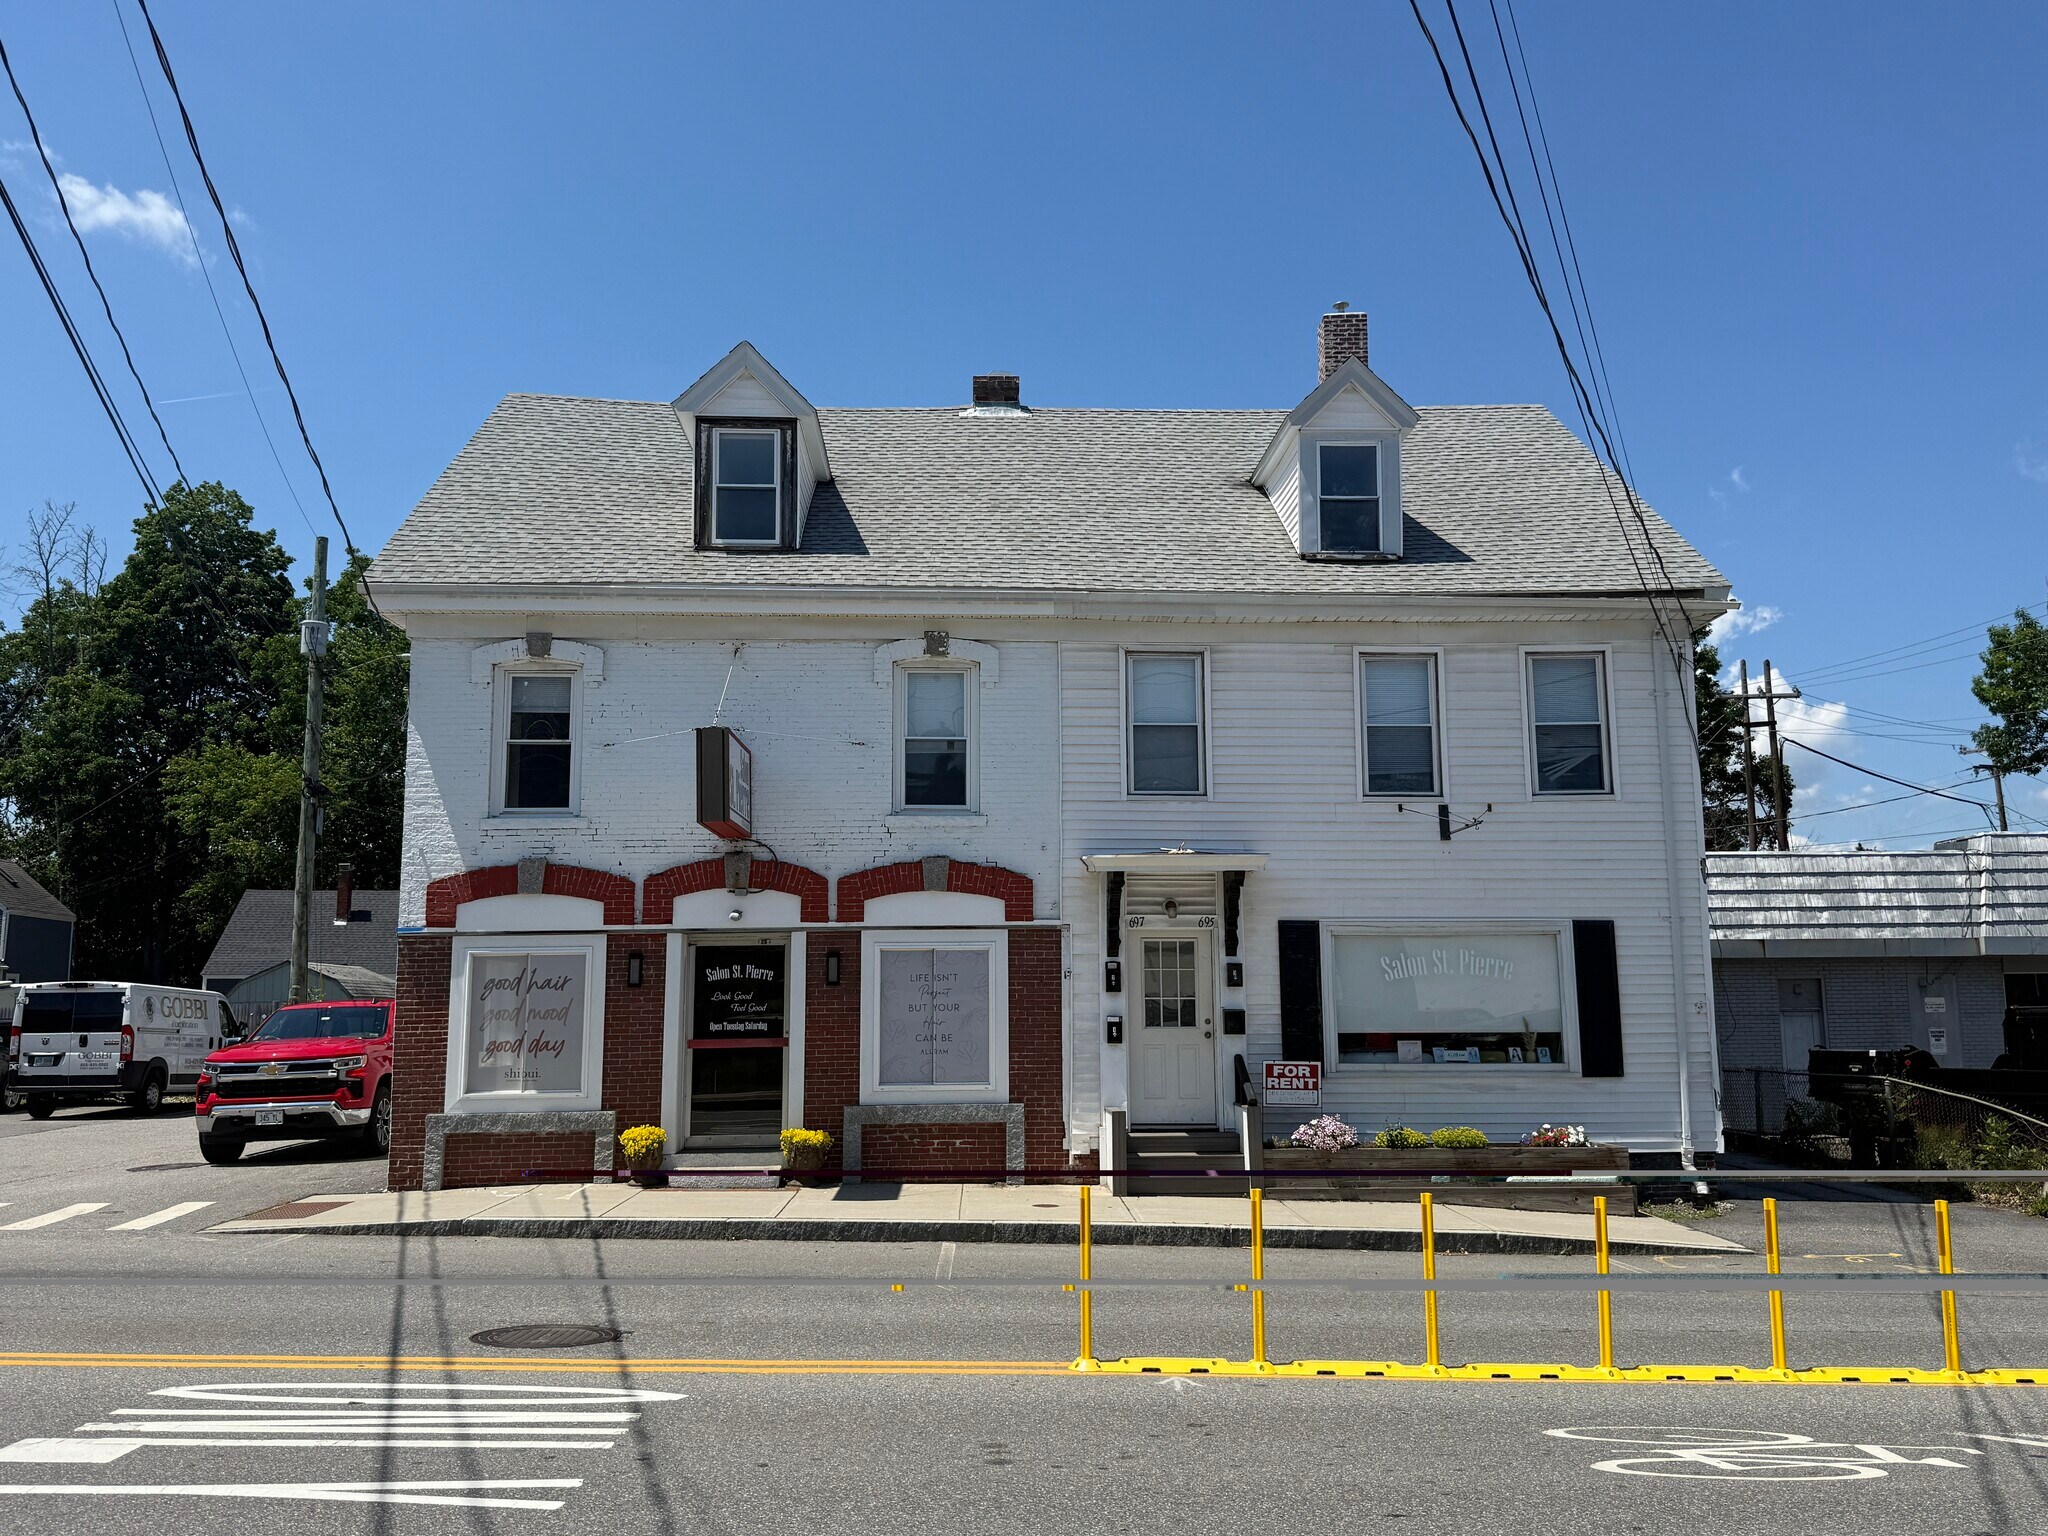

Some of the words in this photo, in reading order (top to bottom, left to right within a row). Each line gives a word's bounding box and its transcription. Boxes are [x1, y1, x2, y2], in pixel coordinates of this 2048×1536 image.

[1129, 916, 1145, 928] 697
[1198, 916, 1214, 928] 695
[1381, 953, 1427, 981] Salon
[1432, 950, 1453, 975] St.
[1460, 949, 1514, 980] Pierre
[706, 966, 730, 981] Salon
[733, 965, 743, 978] St.
[746, 965, 773, 980] Pierre
[910, 974, 929, 982] LIFE
[933, 974, 958, 982] ISN'T
[480, 968, 527, 1001] good
[526, 968, 572, 994] hair
[711, 992, 731, 1001] Look
[734, 992, 753, 1000] Good
[160, 996, 208, 1020] GOBBI
[731, 1003, 747, 1011] Feel
[748, 1003, 767, 1012] Good
[908, 1004, 927, 1012] BUT
[933, 1004, 960, 1012] YOUR
[480, 998, 527, 1031] good
[526, 997, 574, 1026] mood
[710, 1022, 723, 1032] Open
[723, 1022, 744, 1031] Tuesday
[745, 1022, 768, 1031] Saturday
[915, 1034, 937, 1042] CAN
[941, 1034, 953, 1042] BE
[481, 1030, 527, 1063] good
[528, 1029, 565, 1058] day
[1273, 1065, 1310, 1077] FOR
[1267, 1077, 1317, 1089] RENT
